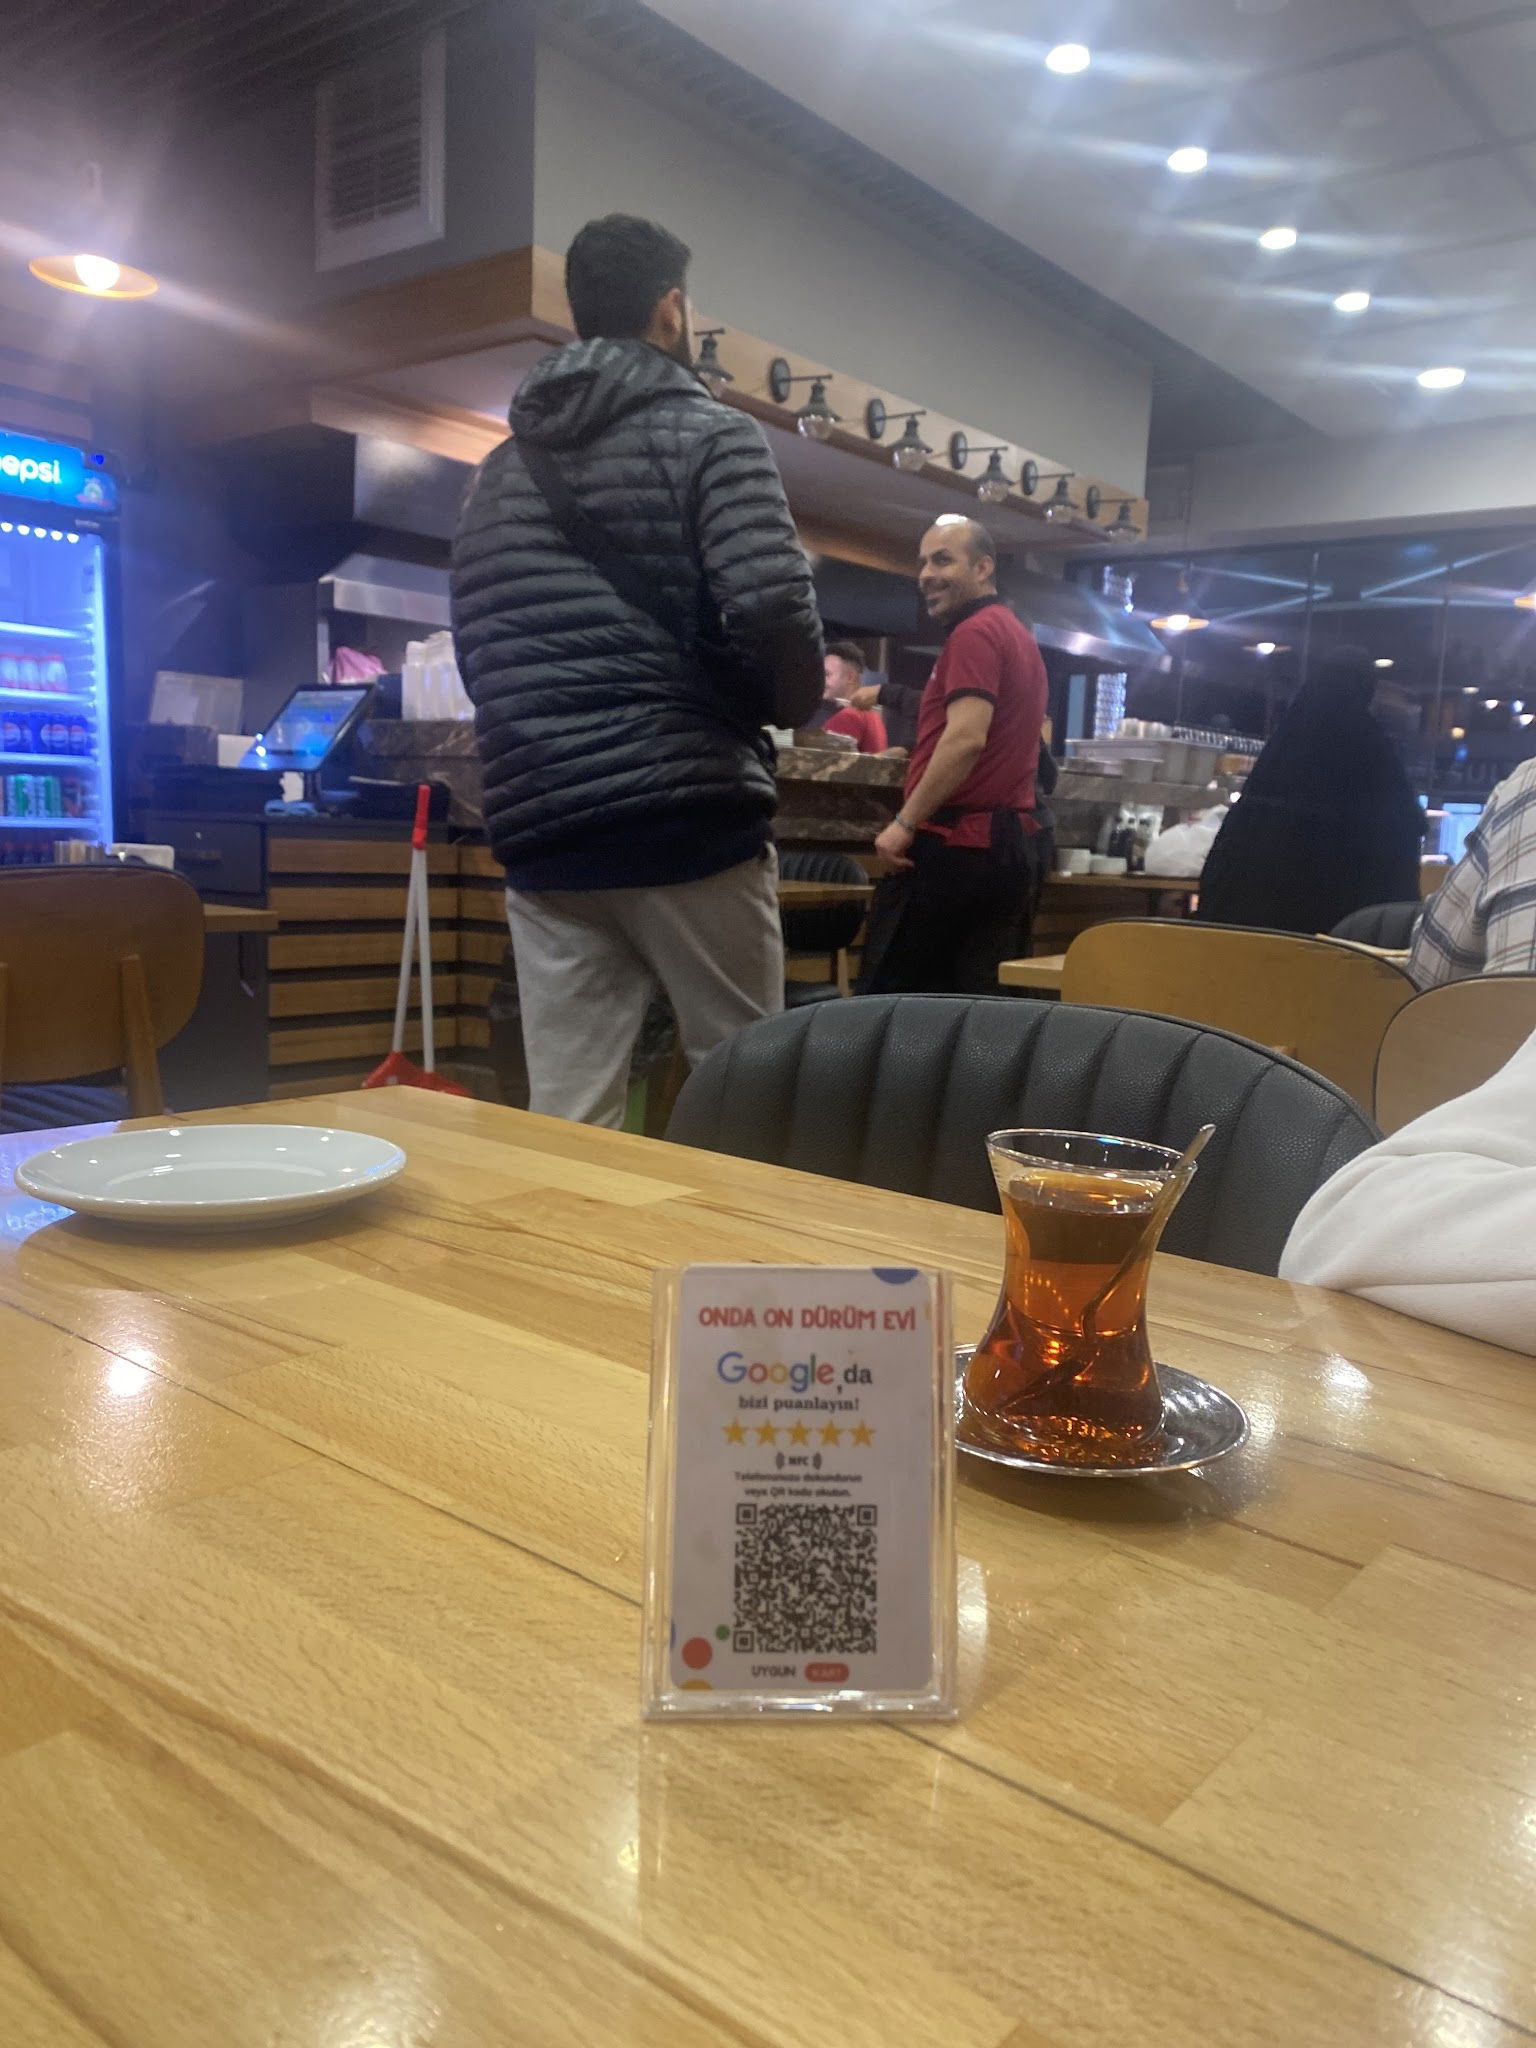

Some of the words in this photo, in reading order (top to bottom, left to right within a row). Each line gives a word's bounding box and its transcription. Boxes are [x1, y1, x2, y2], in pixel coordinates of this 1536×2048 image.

[0, 455, 62, 485] epsi
[699, 1307, 757, 1329] ONDA
[763, 1308, 794, 1329] ON
[801, 1305, 876, 1331] DÜRÜM
[883, 1307, 916, 1331] EVİ
[738, 1396, 768, 1410] bizi
[751, 1665, 797, 1678] UYGUN
